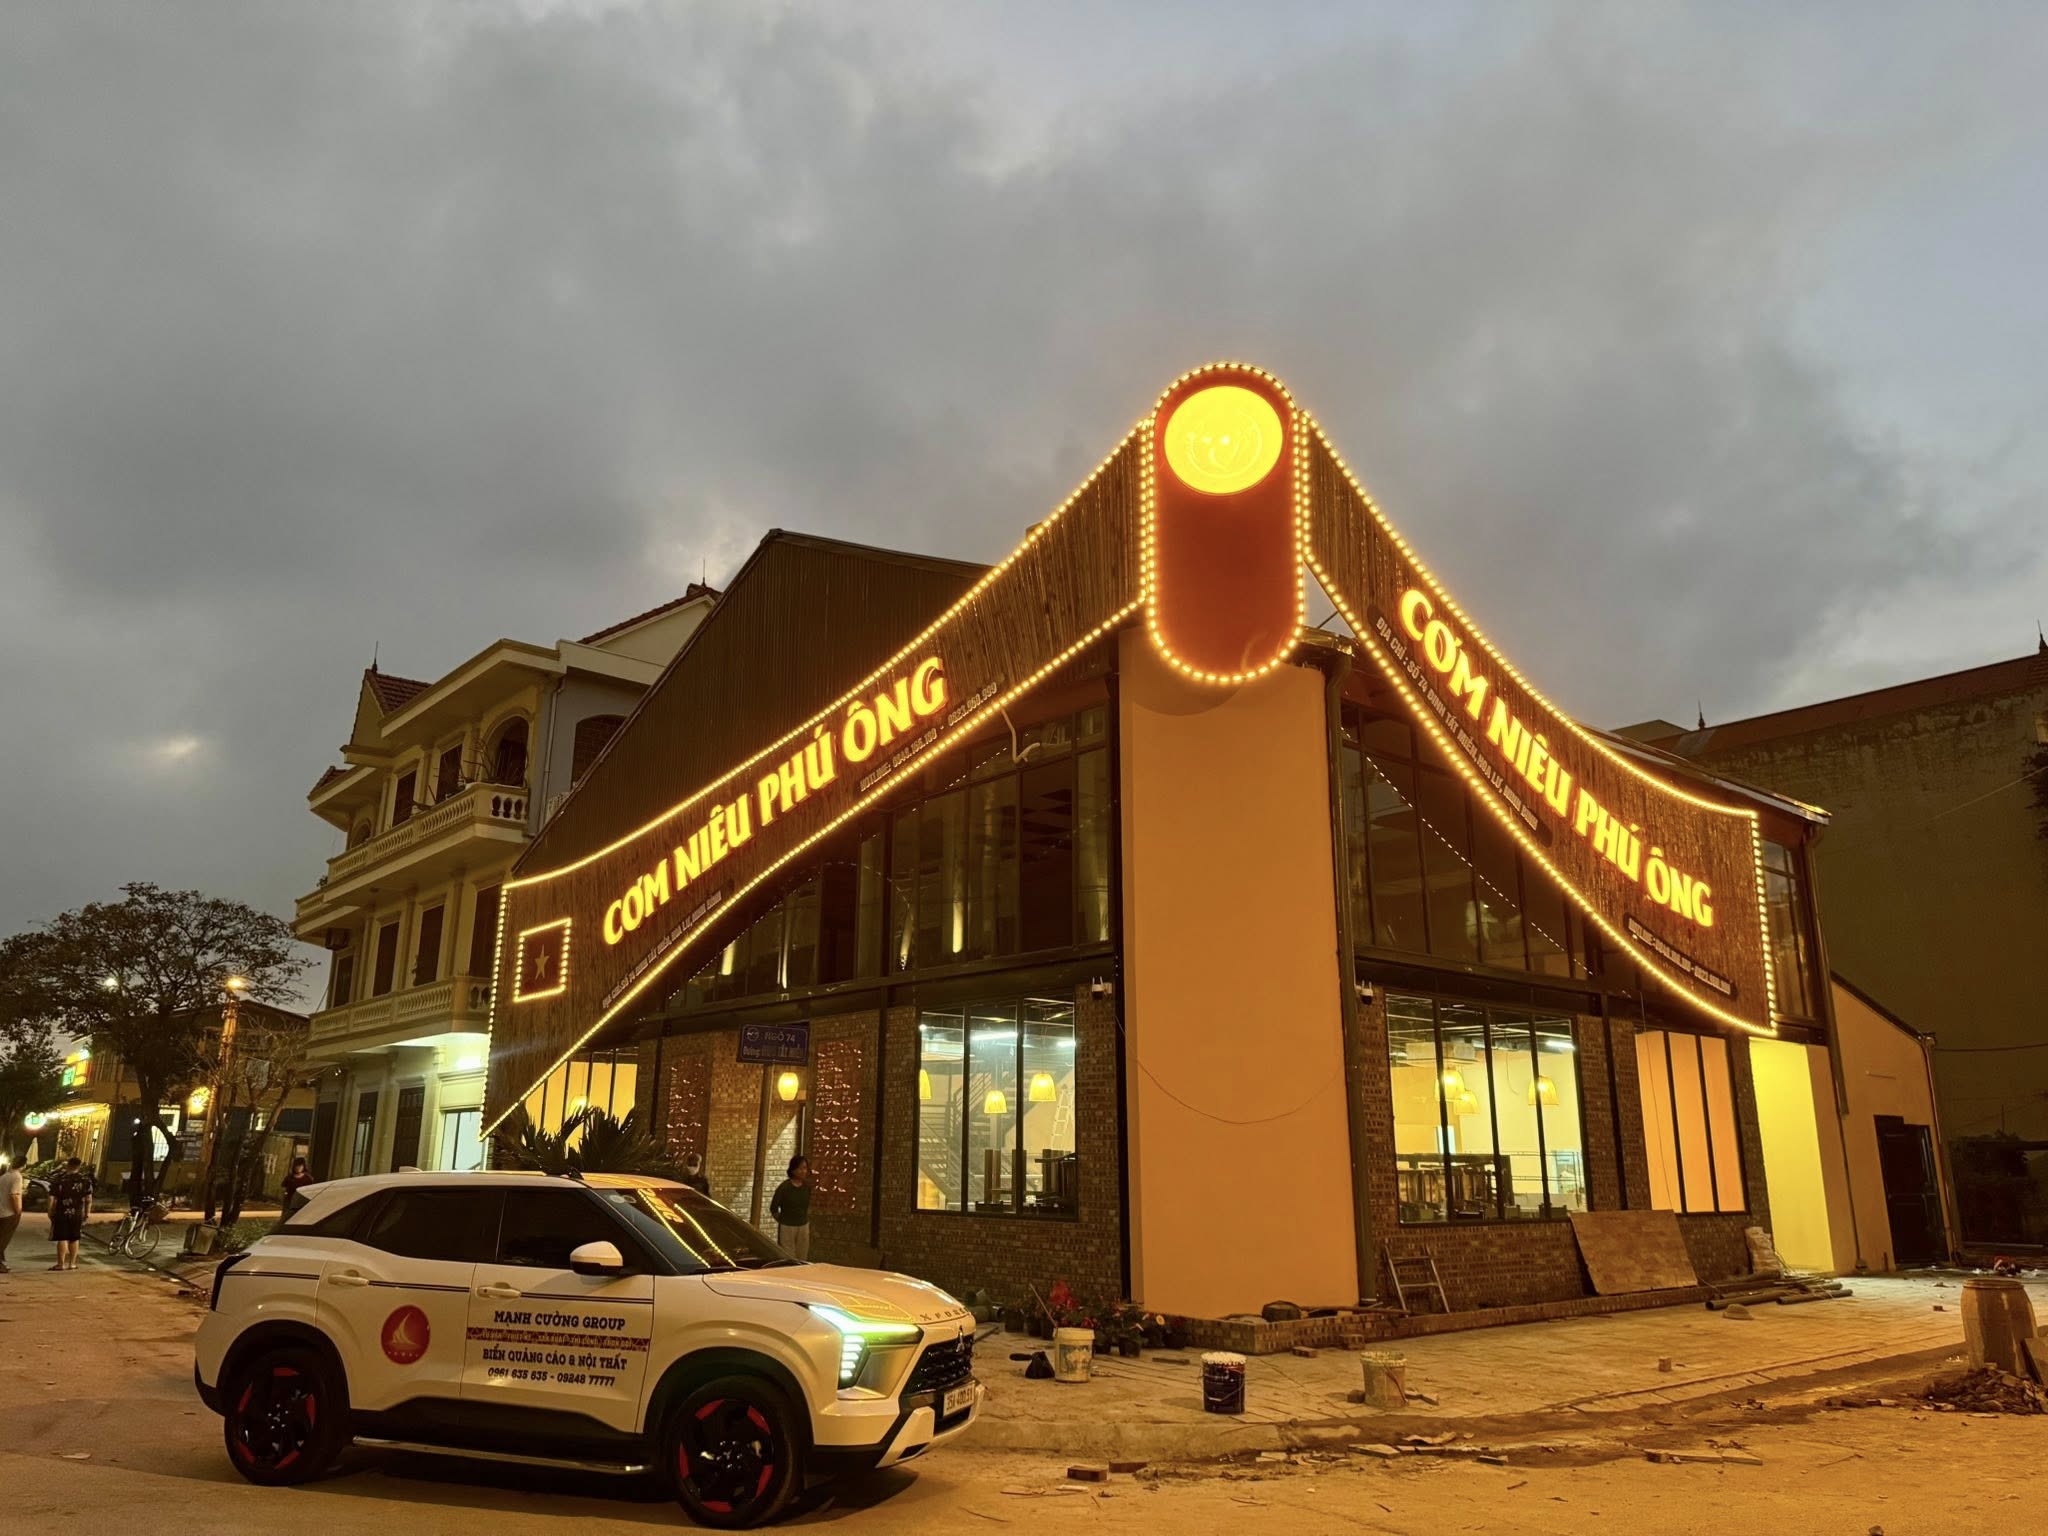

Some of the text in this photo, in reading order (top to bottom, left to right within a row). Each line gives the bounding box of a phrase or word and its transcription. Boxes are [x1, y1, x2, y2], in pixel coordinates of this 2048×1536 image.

[1376, 617, 1392, 642] ĐỊA
[1418, 675, 1428, 692] 74
[1401, 589, 1713, 927] CƠM NIÊU PHÚ ÔNG
[603, 656, 946, 945] CƠM NIÊU PHÚ ÔNG
[494, 1311, 532, 1327] MẠNH
[583, 1315, 625, 1331] GROUP
[508, 1347, 543, 1365] QUẢNG
[545, 1350, 566, 1366] CÁO
[578, 1352, 596, 1371] NỘI
[599, 1352, 627, 1371] THẤT
[589, 1375, 616, 1387] 77777
